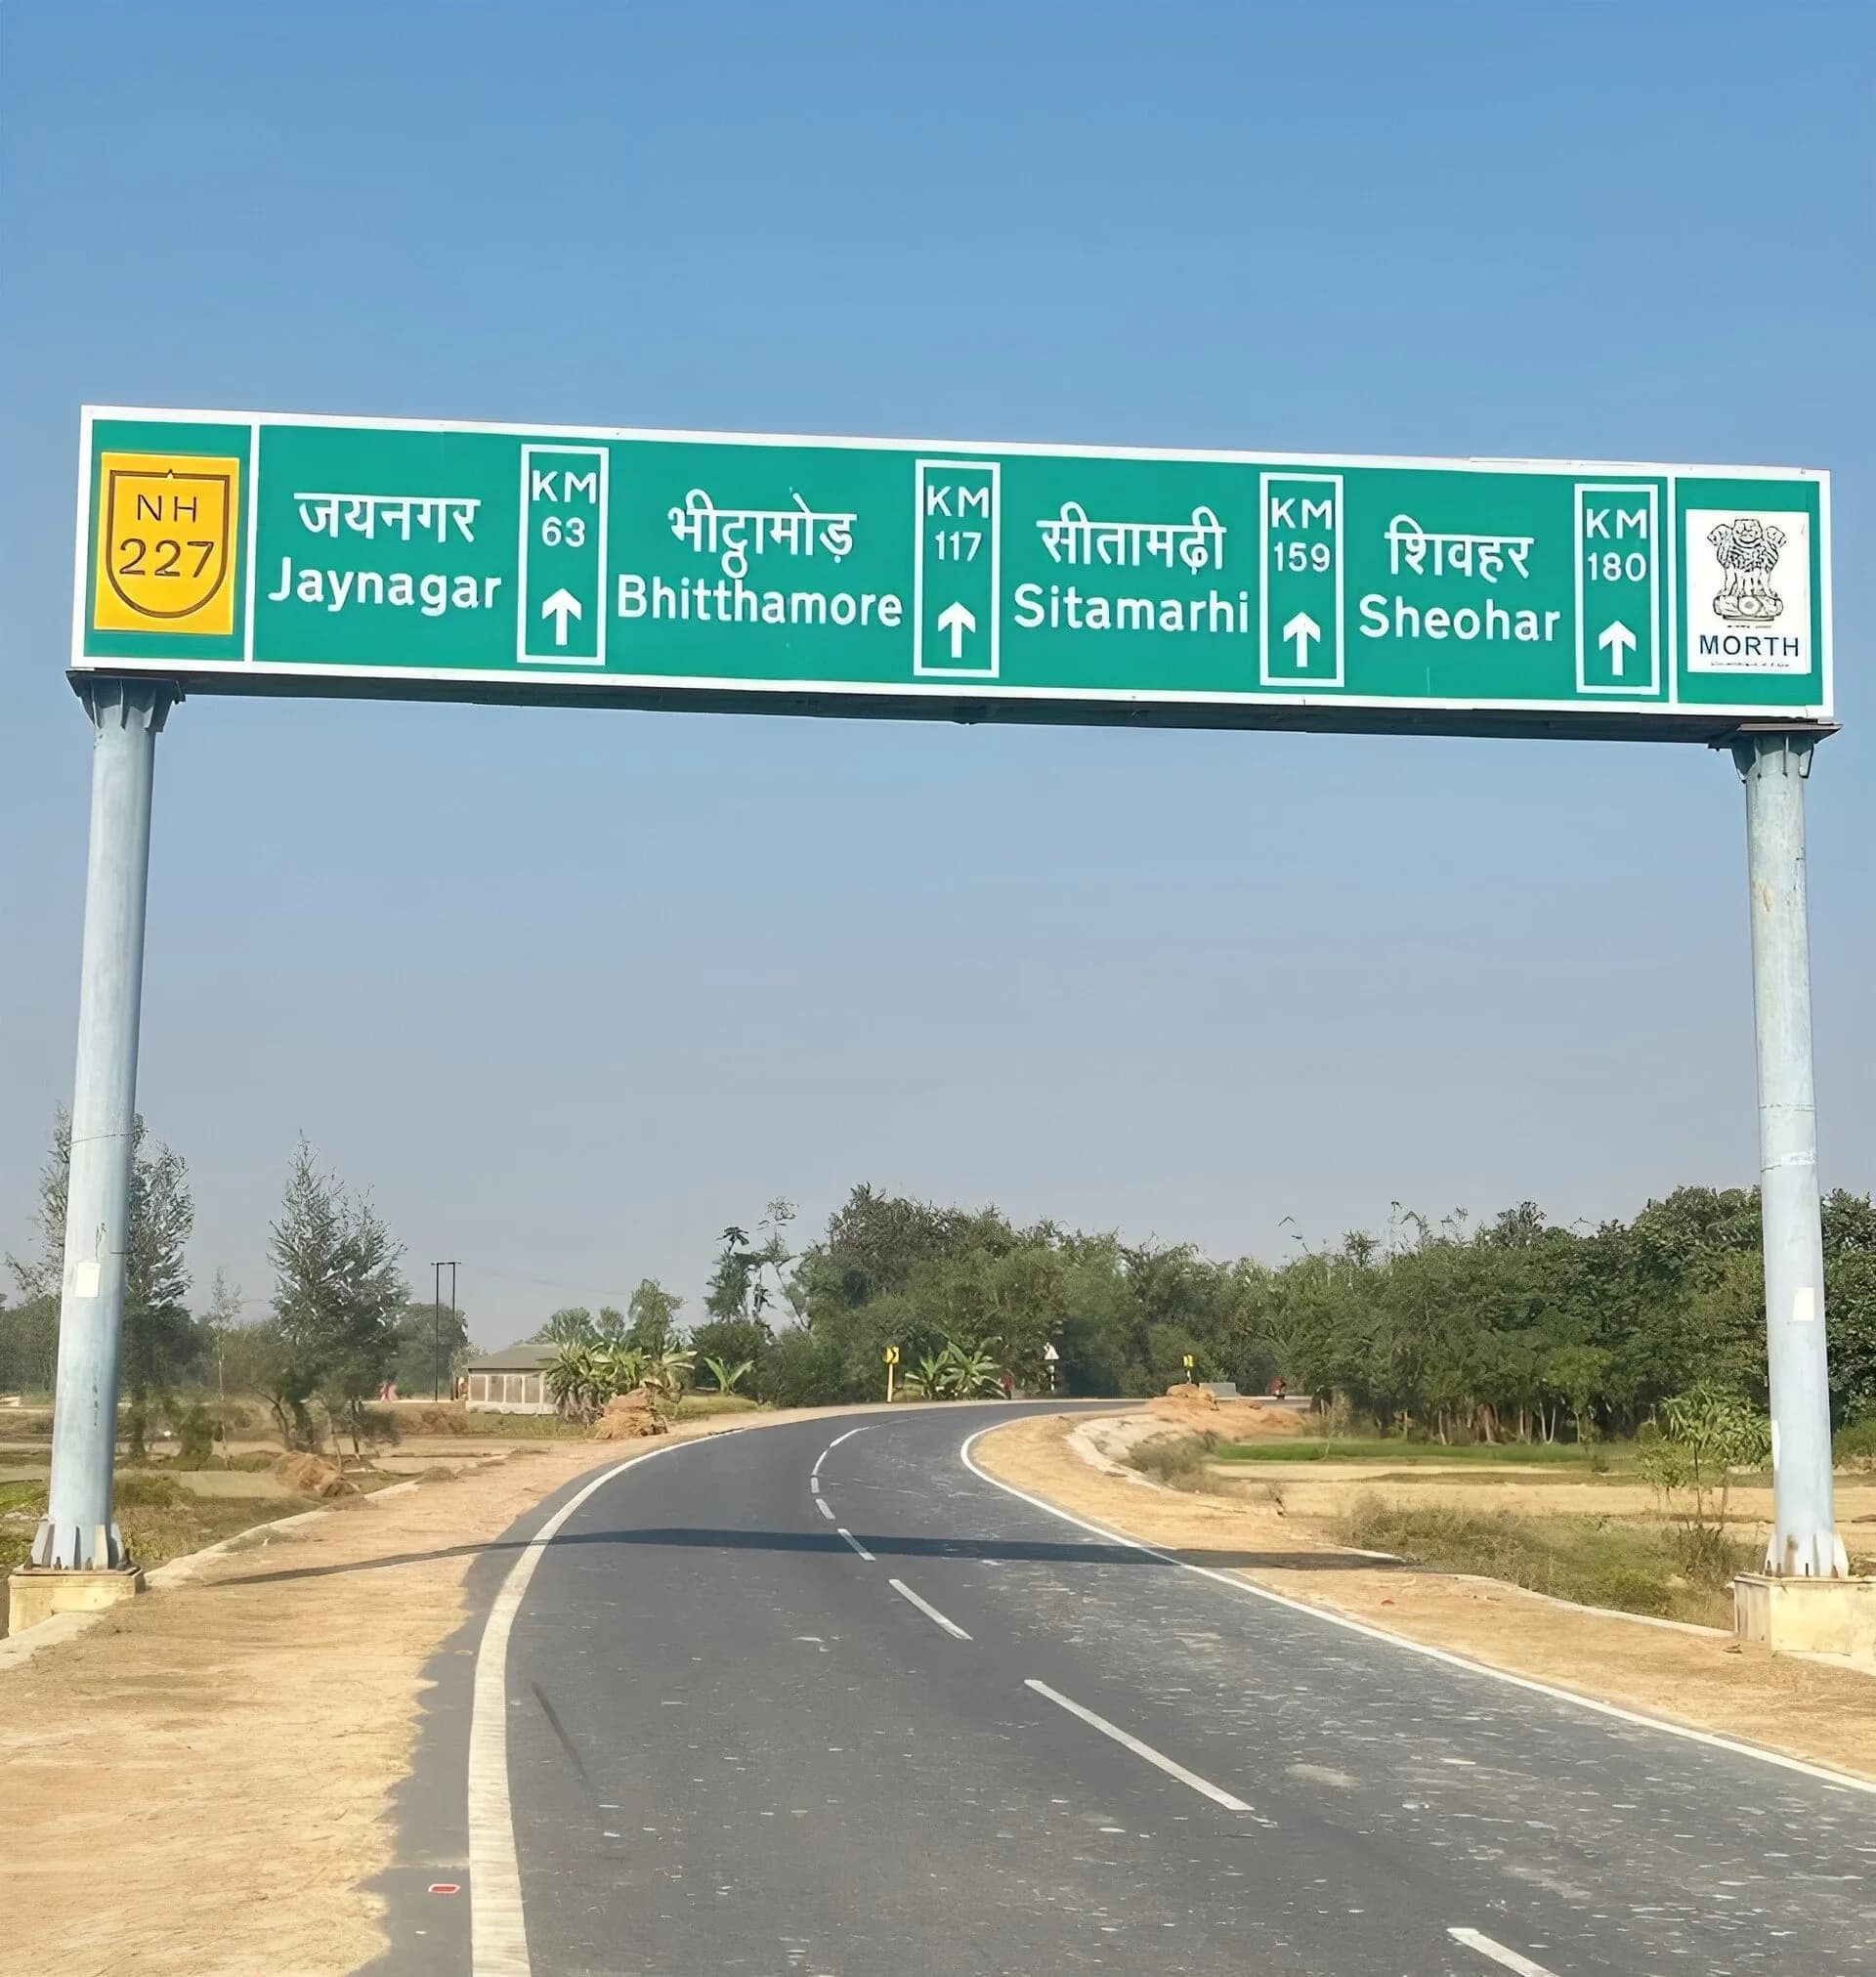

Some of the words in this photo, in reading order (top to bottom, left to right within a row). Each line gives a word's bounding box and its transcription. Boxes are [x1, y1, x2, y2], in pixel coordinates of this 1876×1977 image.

[532, 470, 597, 504] KM
[926, 485, 990, 520] KM
[137, 494, 197, 523] NH
[293, 492, 481, 542] जयनगर
[1270, 496, 1333, 531] KM
[1586, 508, 1648, 540] KM
[542, 517, 586, 547] 63
[934, 531, 982, 562] 117
[1036, 501, 1226, 577] सीतामढ़ी
[1384, 514, 1534, 583] शिवहर
[118, 537, 215, 579] 227
[1274, 541, 1331, 573] 159
[1588, 552, 1647, 582] 180
[268, 556, 502, 617] Jaynagar
[617, 574, 904, 627] Bhitthamore
[1013, 582, 1250, 634] Sitamarhi
[1358, 593, 1561, 642] Sheohar
[1698, 633, 1800, 659] MORTH
